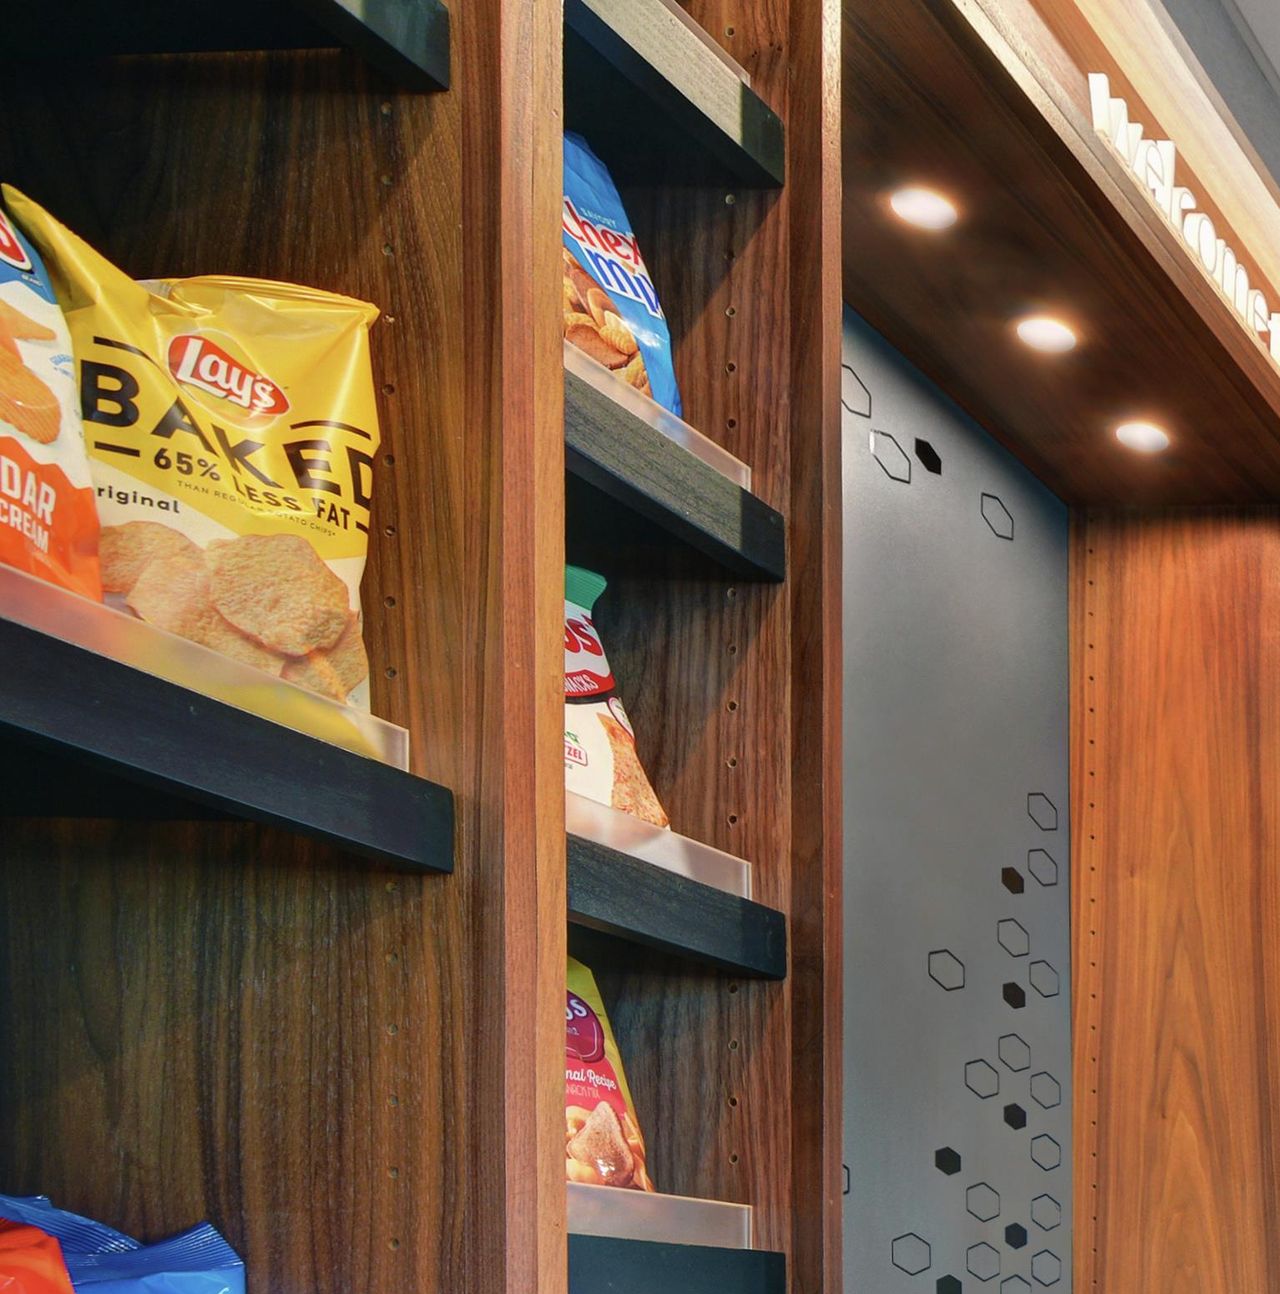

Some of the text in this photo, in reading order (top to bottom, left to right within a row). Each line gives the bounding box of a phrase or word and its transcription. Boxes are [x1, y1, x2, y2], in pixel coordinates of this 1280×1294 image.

[173, 338, 276, 412] Lay's
[80, 360, 375, 512] BAKED
[0, 454, 57, 526] DAR
[97, 485, 180, 514] riginal
[154, 448, 351, 530] 65% LESS FAT
[177, 480, 209, 495] THAN
[565, 673, 598, 692] NACKS
[566, 746, 583, 761] ZEL
[566, 1069, 586, 1082] nal
